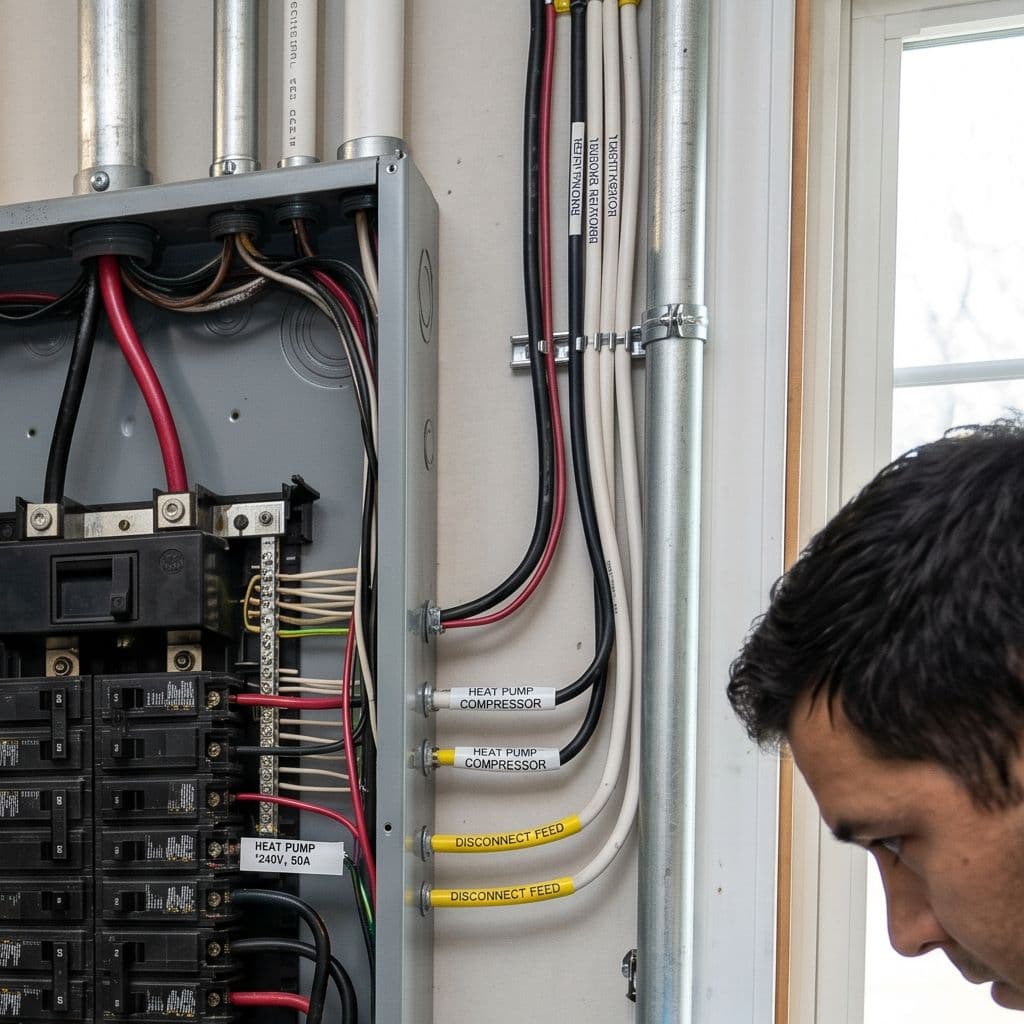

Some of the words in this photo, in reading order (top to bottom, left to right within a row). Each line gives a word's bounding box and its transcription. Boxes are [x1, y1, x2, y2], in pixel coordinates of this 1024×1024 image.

[468, 687, 498, 697] HEAT
[501, 687, 534, 697] PUMP
[460, 698, 542, 709] COMPRESSOR
[473, 748, 502, 757] HEAT
[506, 748, 537, 757] PUMP
[465, 758, 546, 770] COMPRESSOR
[455, 831, 531, 848] DISCONNECT
[534, 822, 565, 840] FEED
[255, 841, 282, 852] HEAT
[285, 842, 316, 853] PUMP
[291, 855, 311, 866] 50A
[450, 887, 527, 902] DISCONNECT
[530, 882, 561, 897] FEED
